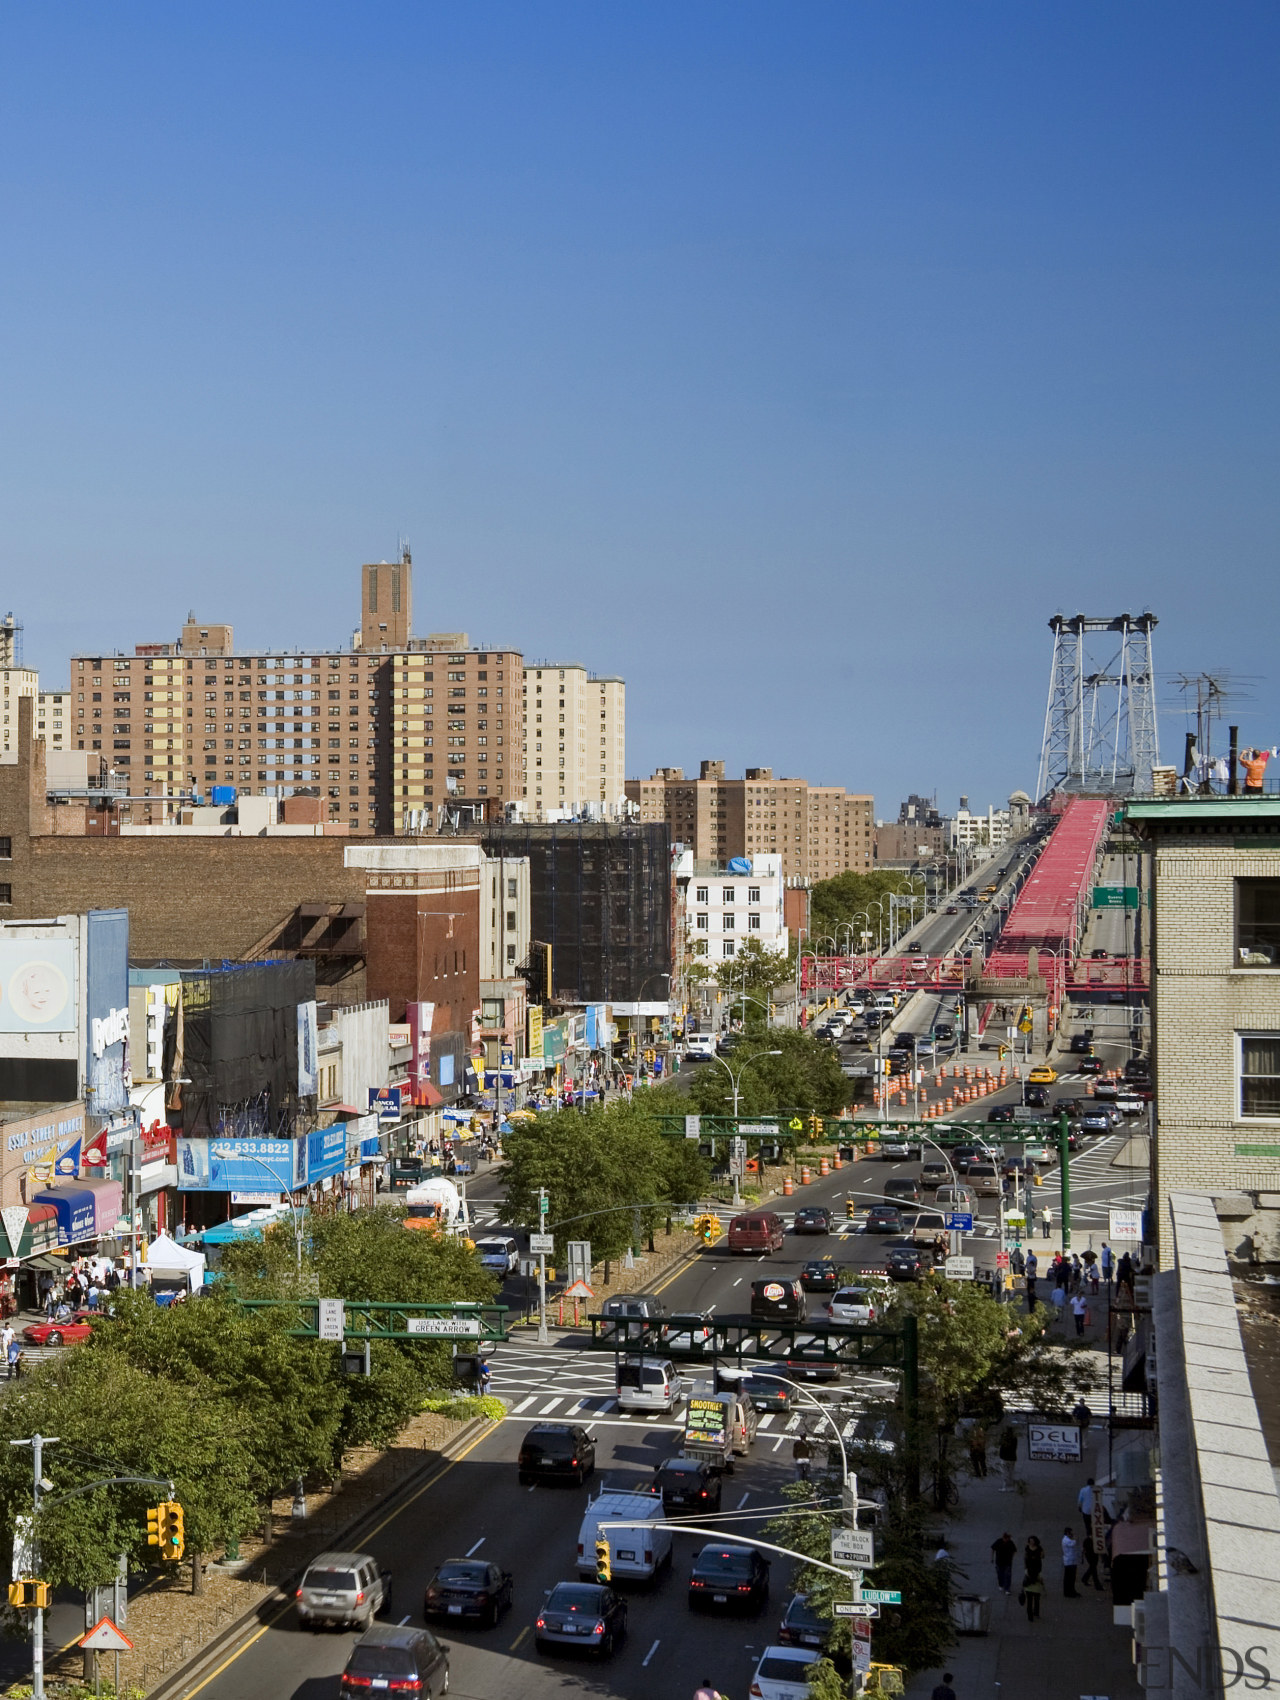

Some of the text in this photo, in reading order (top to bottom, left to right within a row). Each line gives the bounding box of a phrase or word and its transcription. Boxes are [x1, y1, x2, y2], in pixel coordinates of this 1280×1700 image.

[8, 1132, 28, 1151] ESSEX
[31, 1124, 55, 1144] STREET
[58, 1116, 83, 1137] MARKET
[211, 1142, 289, 1154] 212.533.8822
[442, 1325, 471, 1333] ARROW
[690, 1400, 723, 1410] SMOOTHIES
[1031, 1430, 1078, 1443] DELI
[1052, 1452, 1066, 1460] 24
[1092, 1490, 1104, 1552] TAXES
[833, 1533, 870, 1543] DON'T BLOCK
[840, 1541, 864, 1550] THE BOX
[864, 1590, 890, 1601] LUDLOW
